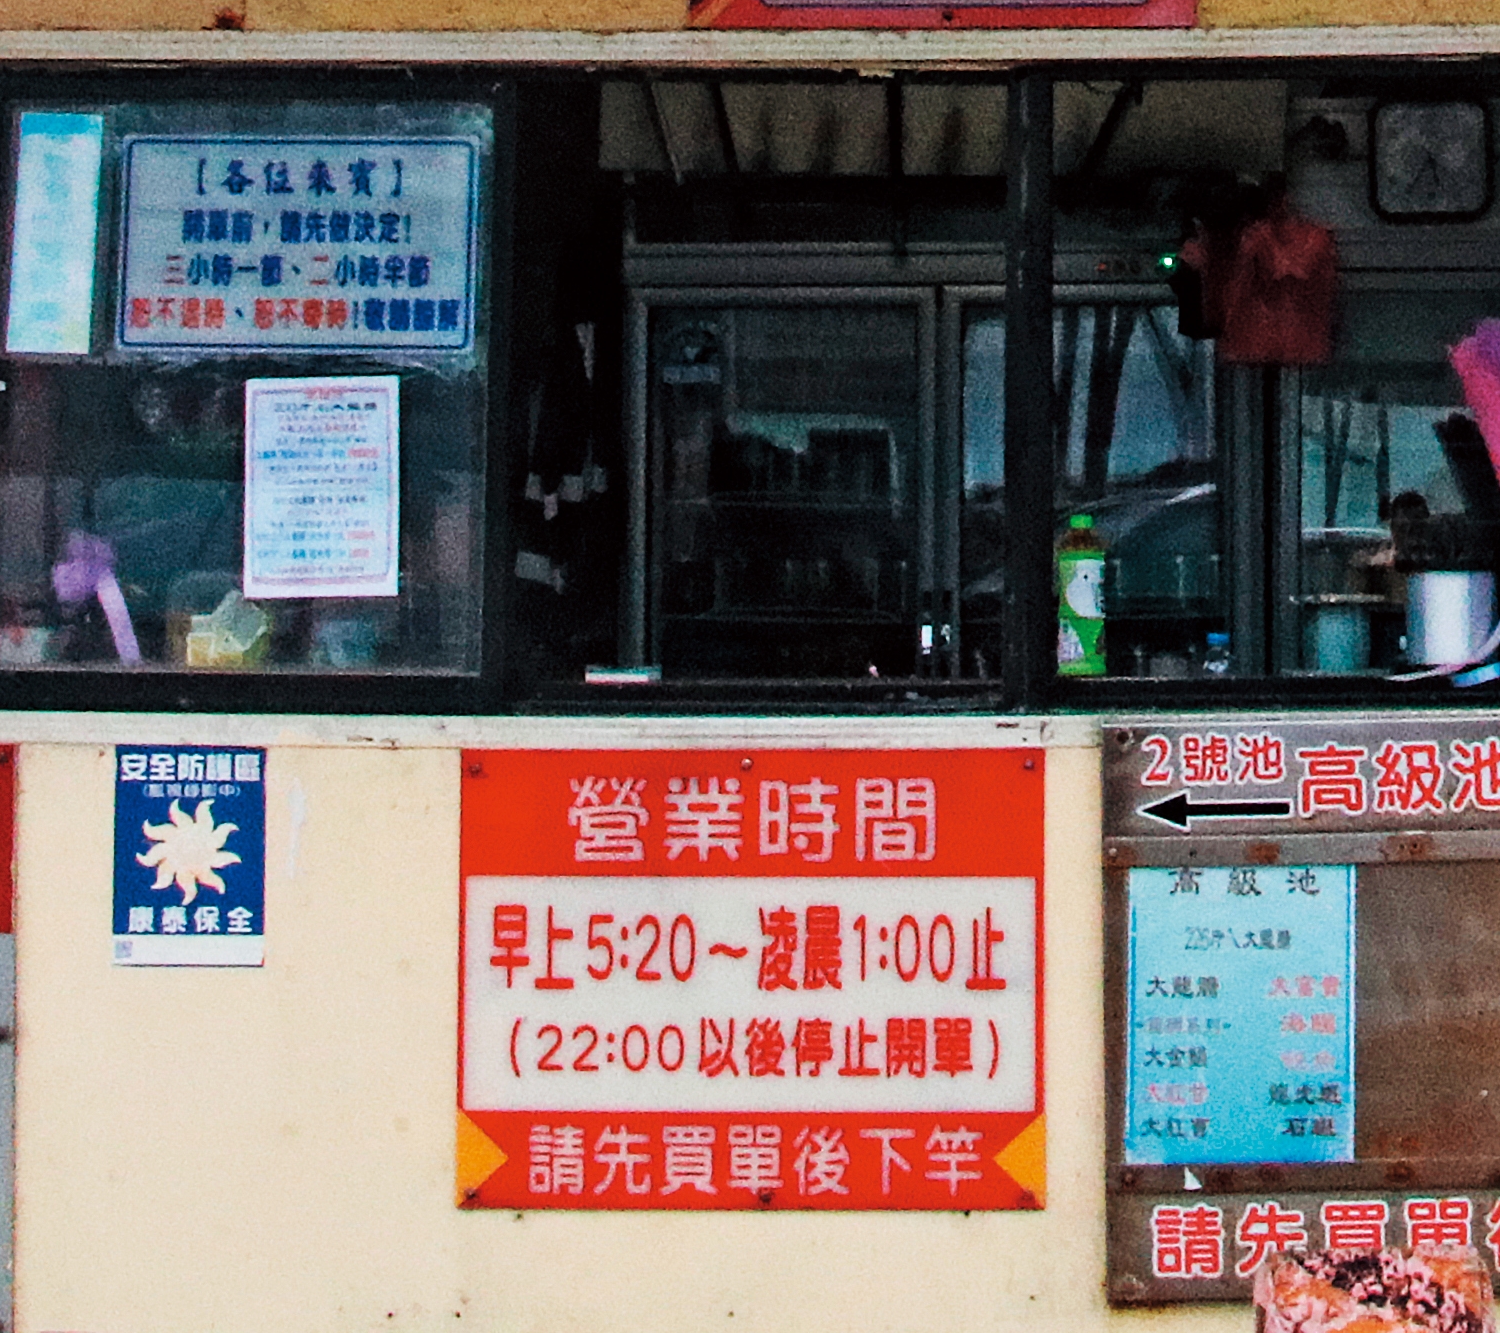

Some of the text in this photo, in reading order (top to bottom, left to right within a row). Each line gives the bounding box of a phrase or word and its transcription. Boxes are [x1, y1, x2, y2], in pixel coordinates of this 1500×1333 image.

[120, 753, 261, 781] 安全防護區
[1140, 734, 1284, 786] 2號池
[567, 775, 937, 863] 營業時間
[528, 1124, 984, 1197] 請先買單後下竿
